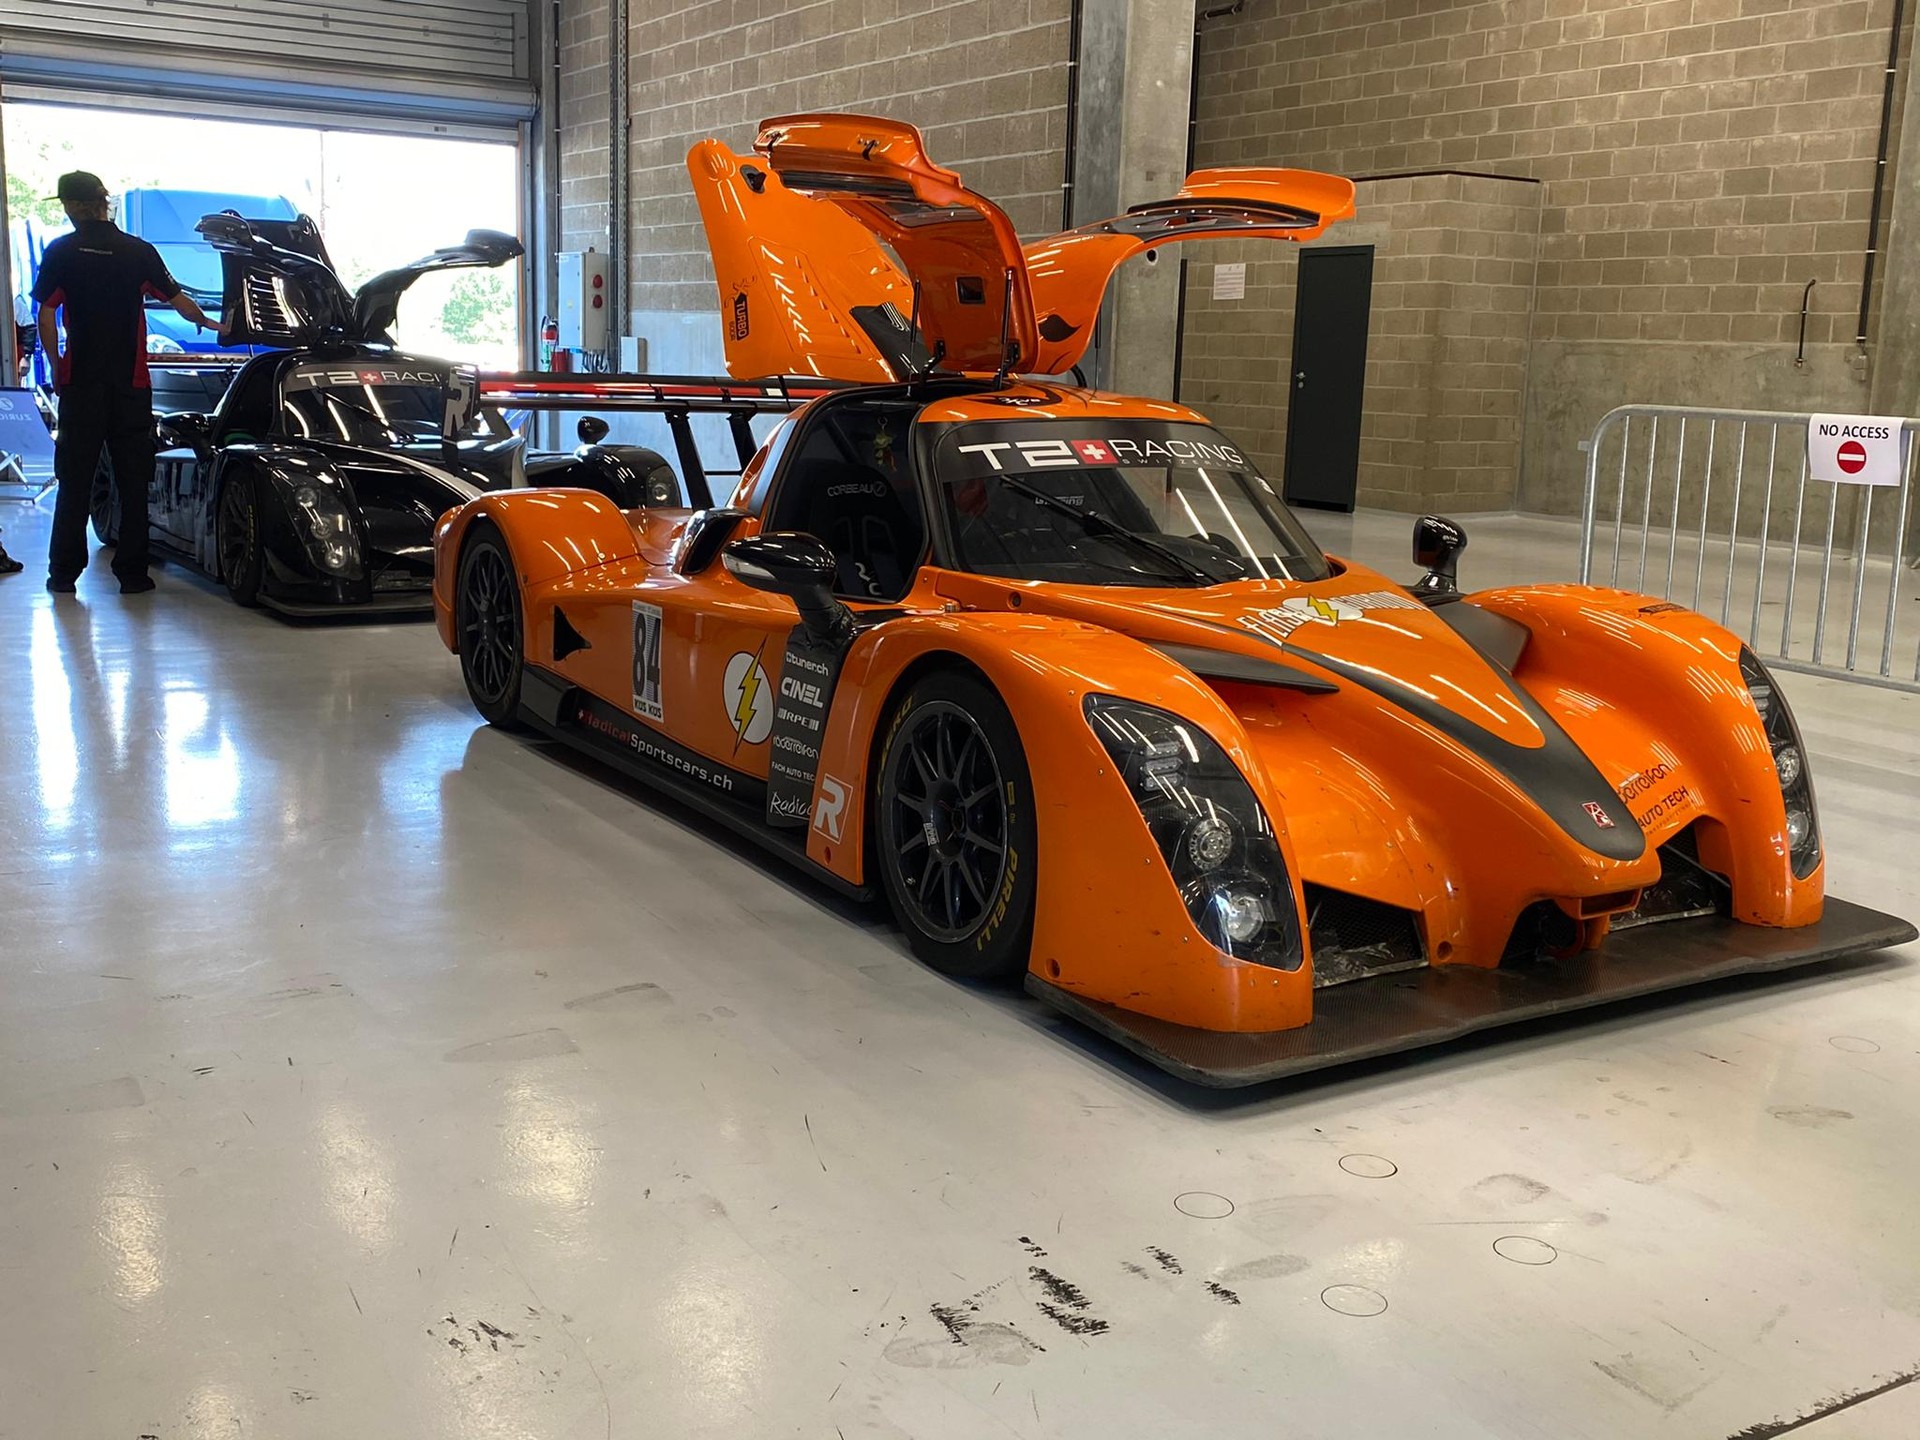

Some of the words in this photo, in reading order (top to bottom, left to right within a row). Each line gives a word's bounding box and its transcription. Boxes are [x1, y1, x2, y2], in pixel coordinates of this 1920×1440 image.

[736, 300, 747, 337] TURBO
[297, 371, 360, 386] T2
[1819, 424, 1839, 437] NO
[1841, 425, 1889, 439] ACCESS
[958, 440, 1079, 470] T2
[1107, 439, 1243, 464] RACING
[827, 483, 873, 497] CORBEAU
[632, 613, 661, 704] 84
[781, 677, 823, 708] CINEL
[786, 711, 810, 728] RPE
[583, 710, 733, 791] RadicalSportscars.ch
[786, 767, 802, 778] AUTO
[814, 777, 845, 839] R
[1661, 785, 1690, 810] TECH
[976, 846, 1018, 951] PIRELLI
